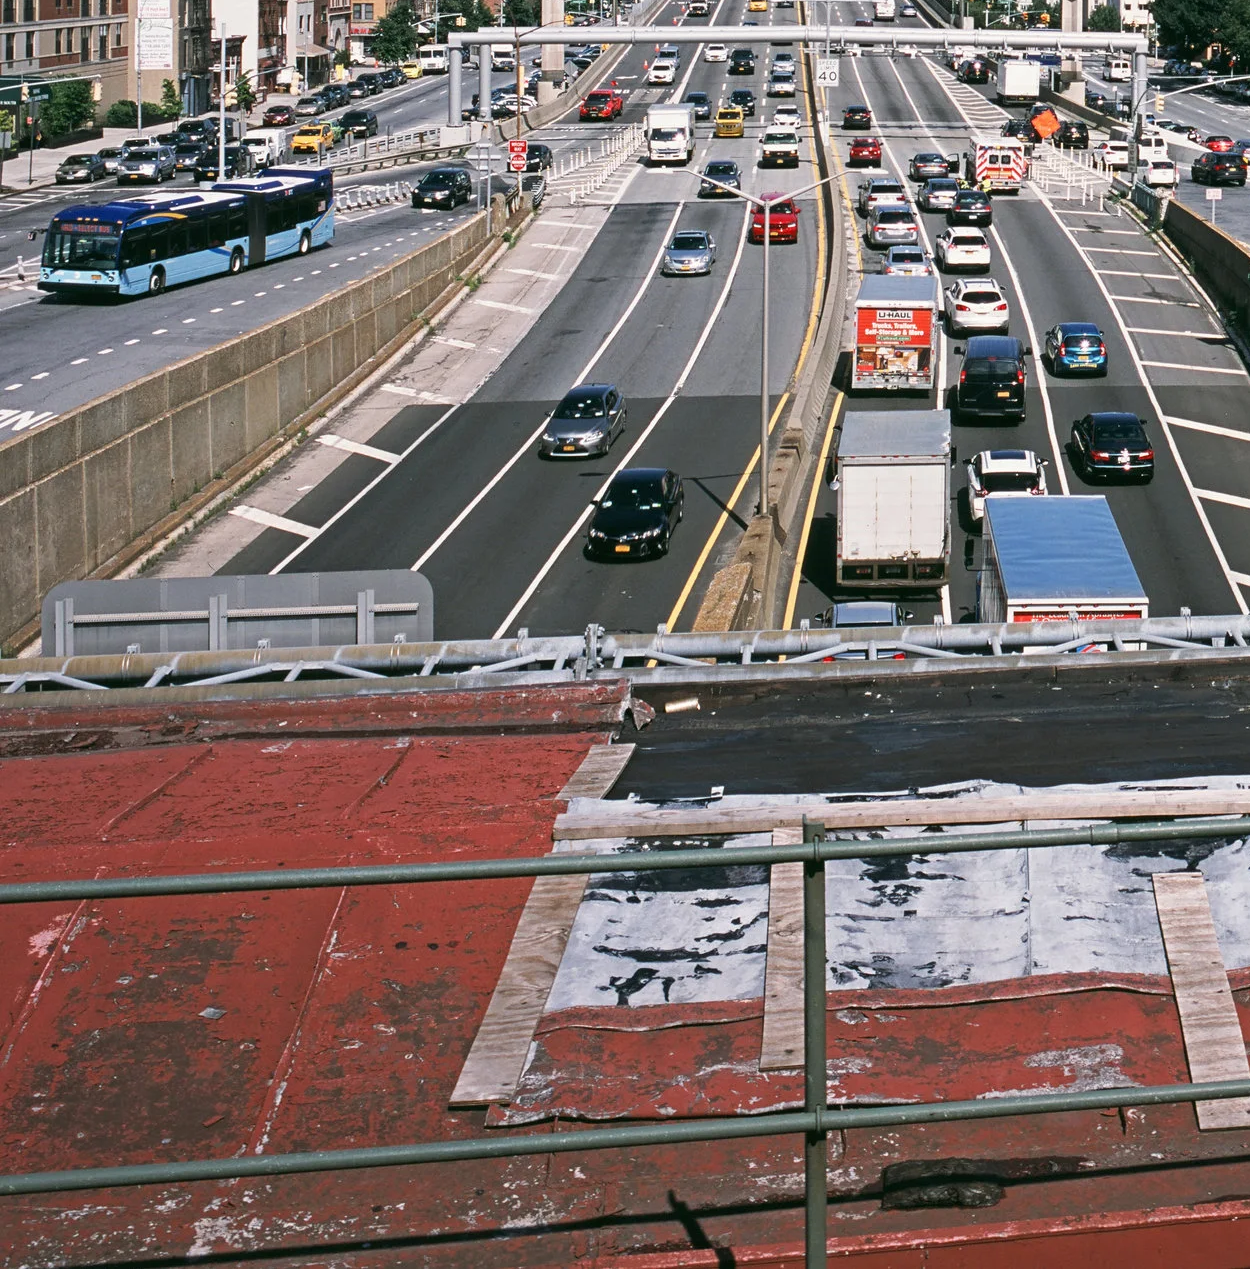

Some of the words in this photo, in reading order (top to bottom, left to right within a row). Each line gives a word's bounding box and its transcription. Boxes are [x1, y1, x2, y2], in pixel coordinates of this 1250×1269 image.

[818, 71, 837, 81] 40
[894, 322, 917, 330] Trailers,
[864, 329, 901, 337] Self-Storage
